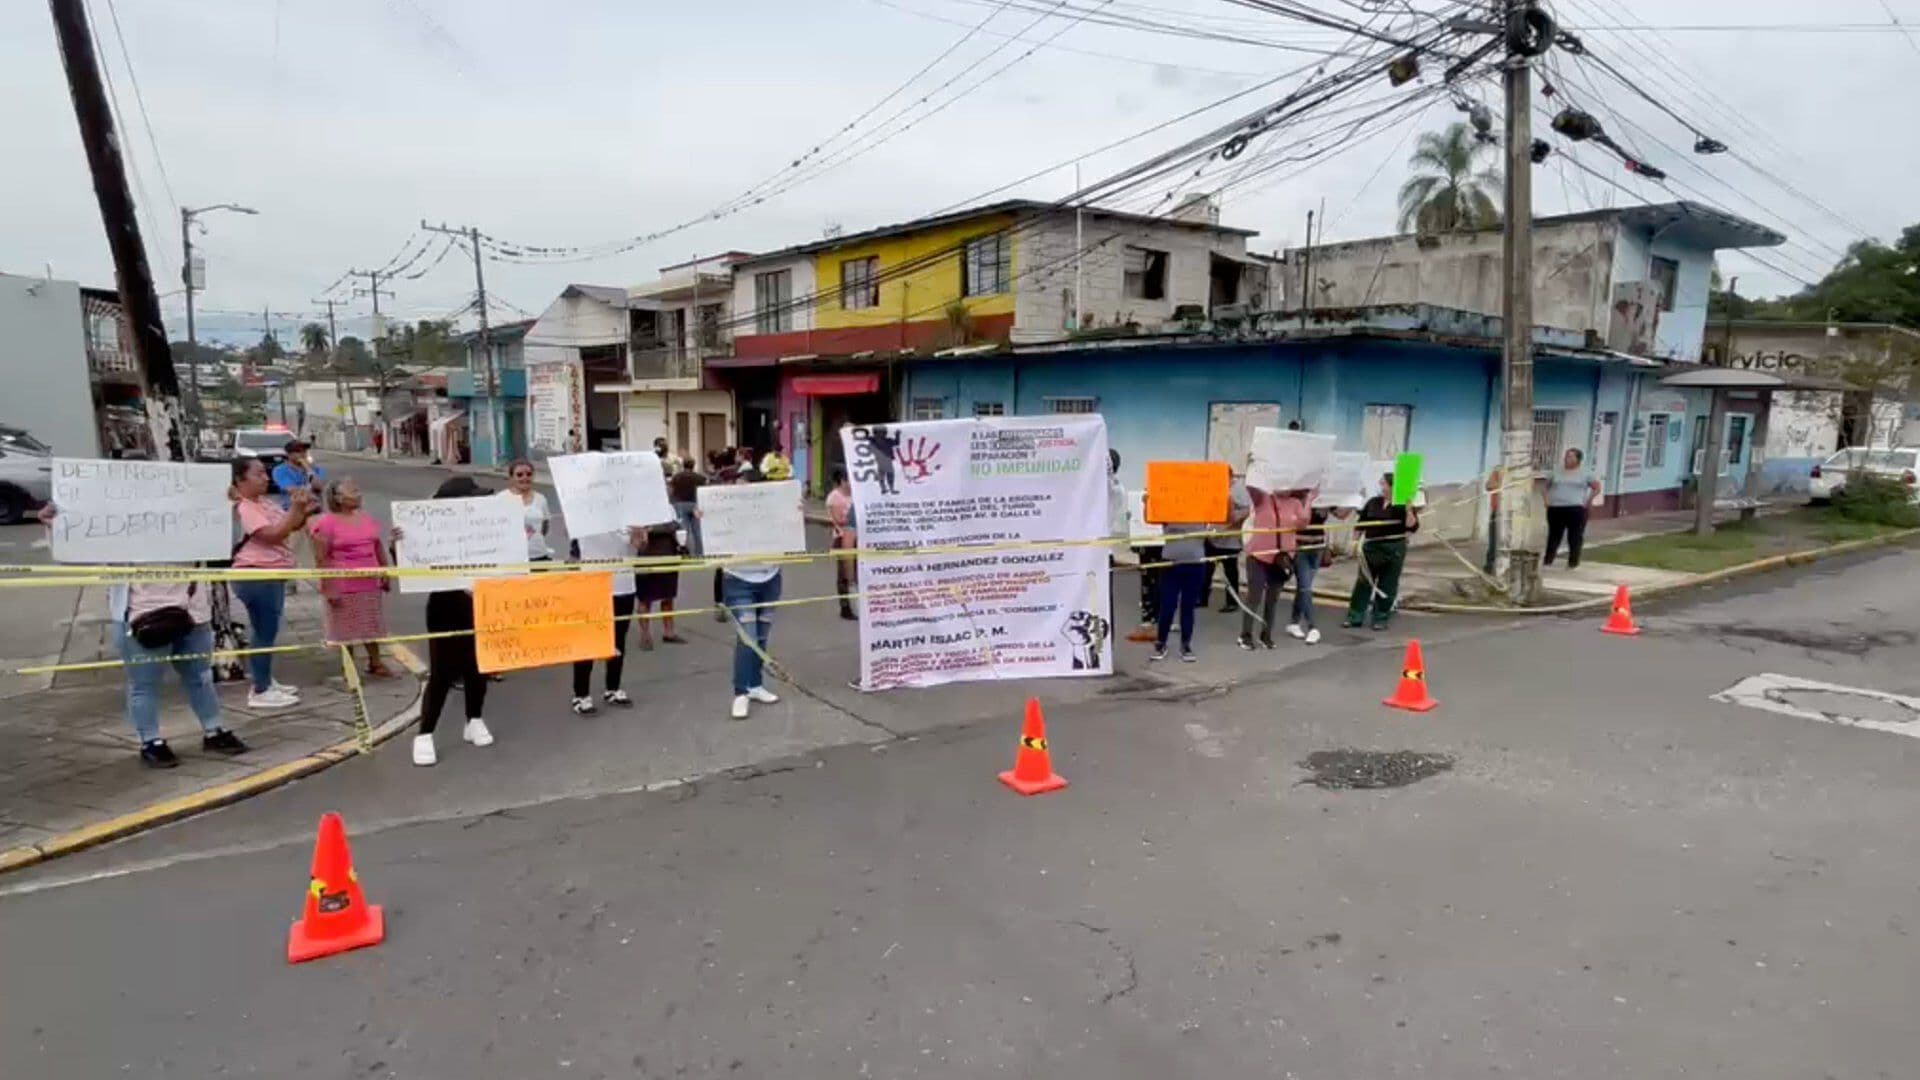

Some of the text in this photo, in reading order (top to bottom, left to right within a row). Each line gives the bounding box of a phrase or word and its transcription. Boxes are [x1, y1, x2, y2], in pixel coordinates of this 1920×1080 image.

[1729, 350, 1802, 369] rvicio
[852, 429, 878, 482] Stop
[970, 457, 1081, 475] NO IMPUNIDAD
[978, 496, 991, 504] DE
[994, 495, 1006, 503] LA
[992, 532, 1006, 541] DE
[1008, 531, 1021, 540] LA
[870, 634, 926, 652] MARTIN
[930, 629, 973, 645] ISAAC
[991, 624, 1010, 638] M.
